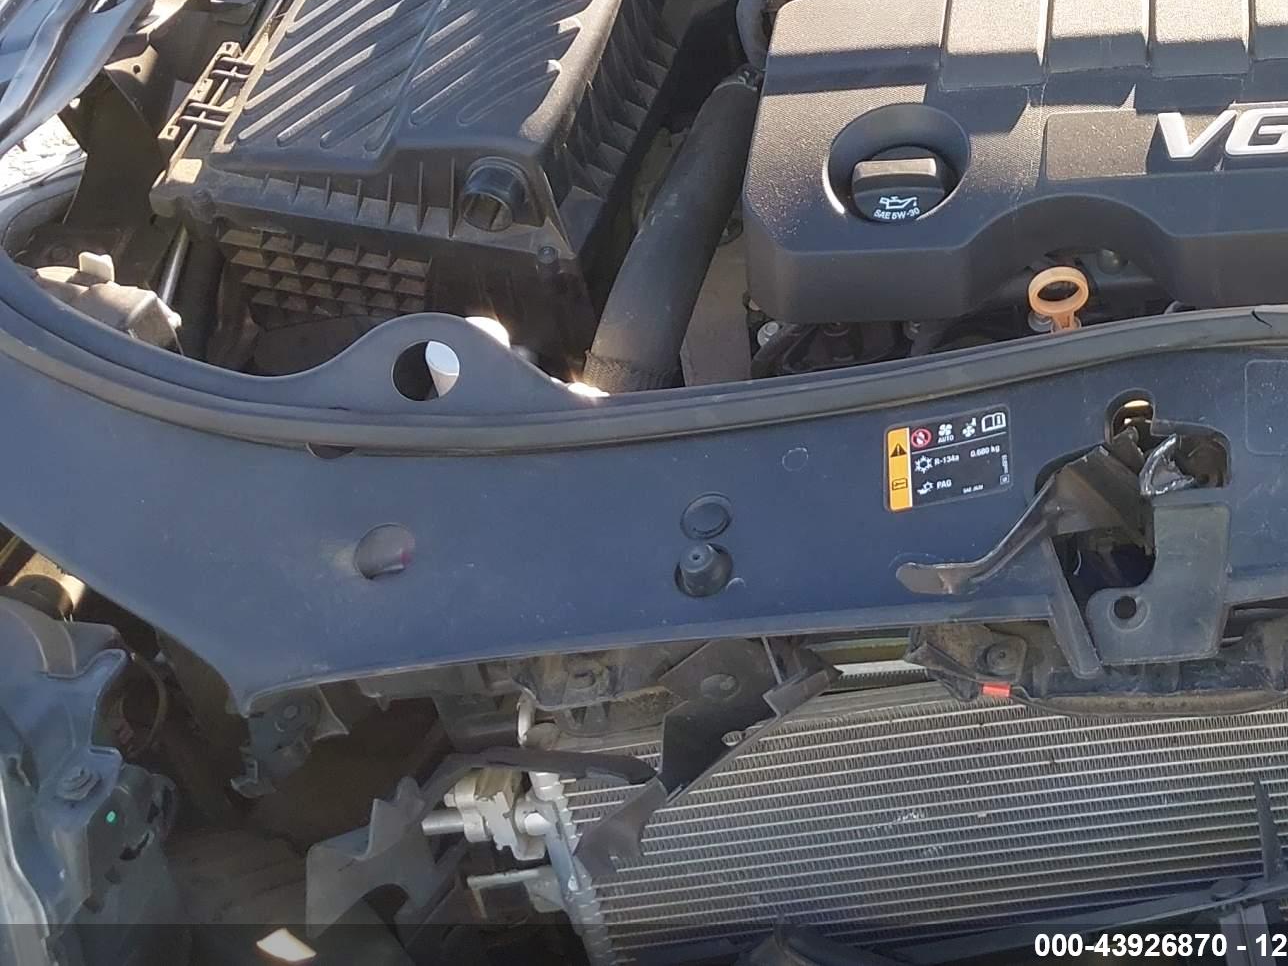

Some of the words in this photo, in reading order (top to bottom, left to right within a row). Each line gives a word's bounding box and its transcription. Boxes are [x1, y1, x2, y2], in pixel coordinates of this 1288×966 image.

[873, 209, 891, 219] SAE
[938, 435, 954, 443] AUTO
[934, 454, 960, 466] R-134a
